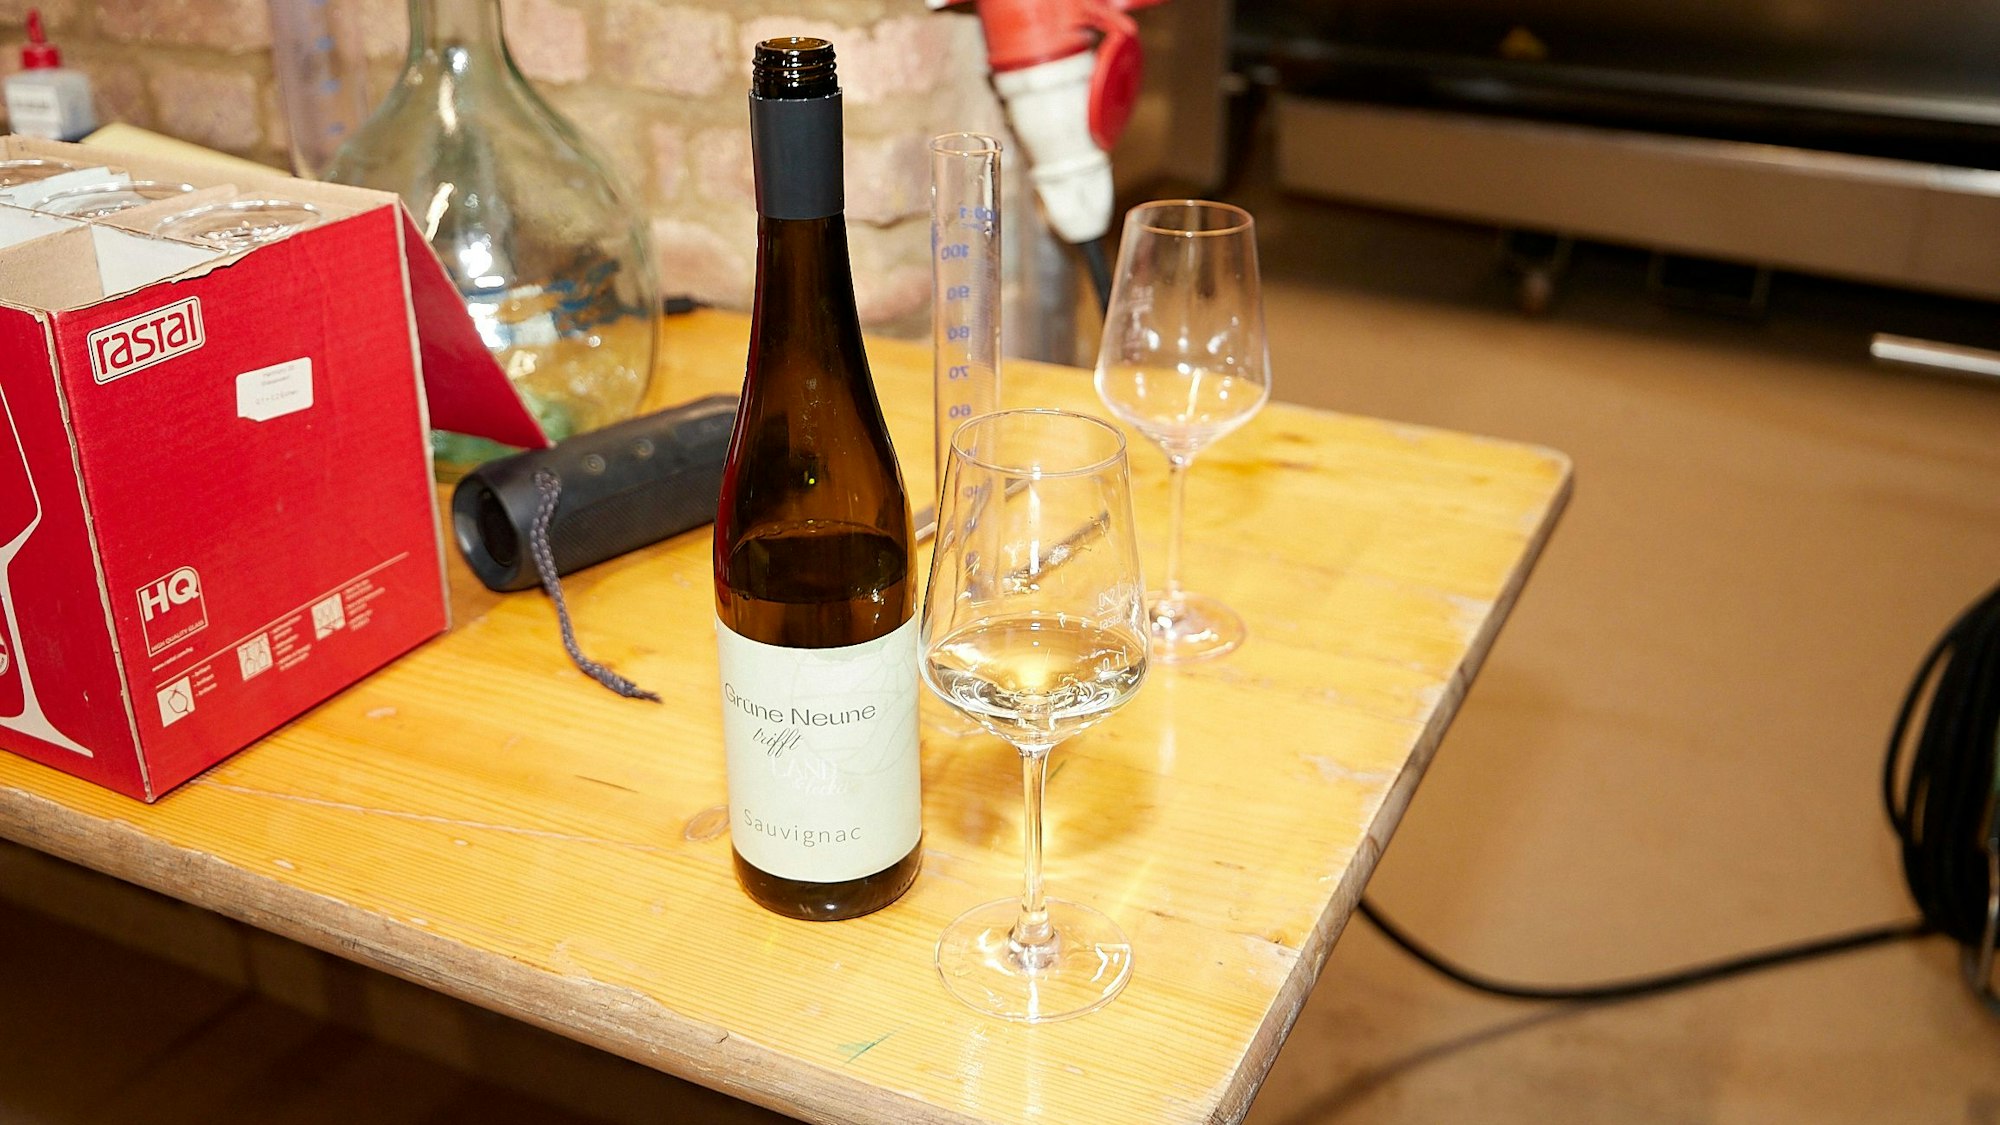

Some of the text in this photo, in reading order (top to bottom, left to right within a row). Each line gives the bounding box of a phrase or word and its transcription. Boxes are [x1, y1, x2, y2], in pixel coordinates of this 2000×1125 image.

[96, 303, 198, 375] rastal
[140, 569, 200, 622] HQ
[725, 682, 876, 726] Grüne Neune
[752, 728, 804, 759] trifft
[744, 808, 862, 848] Sauvignac
